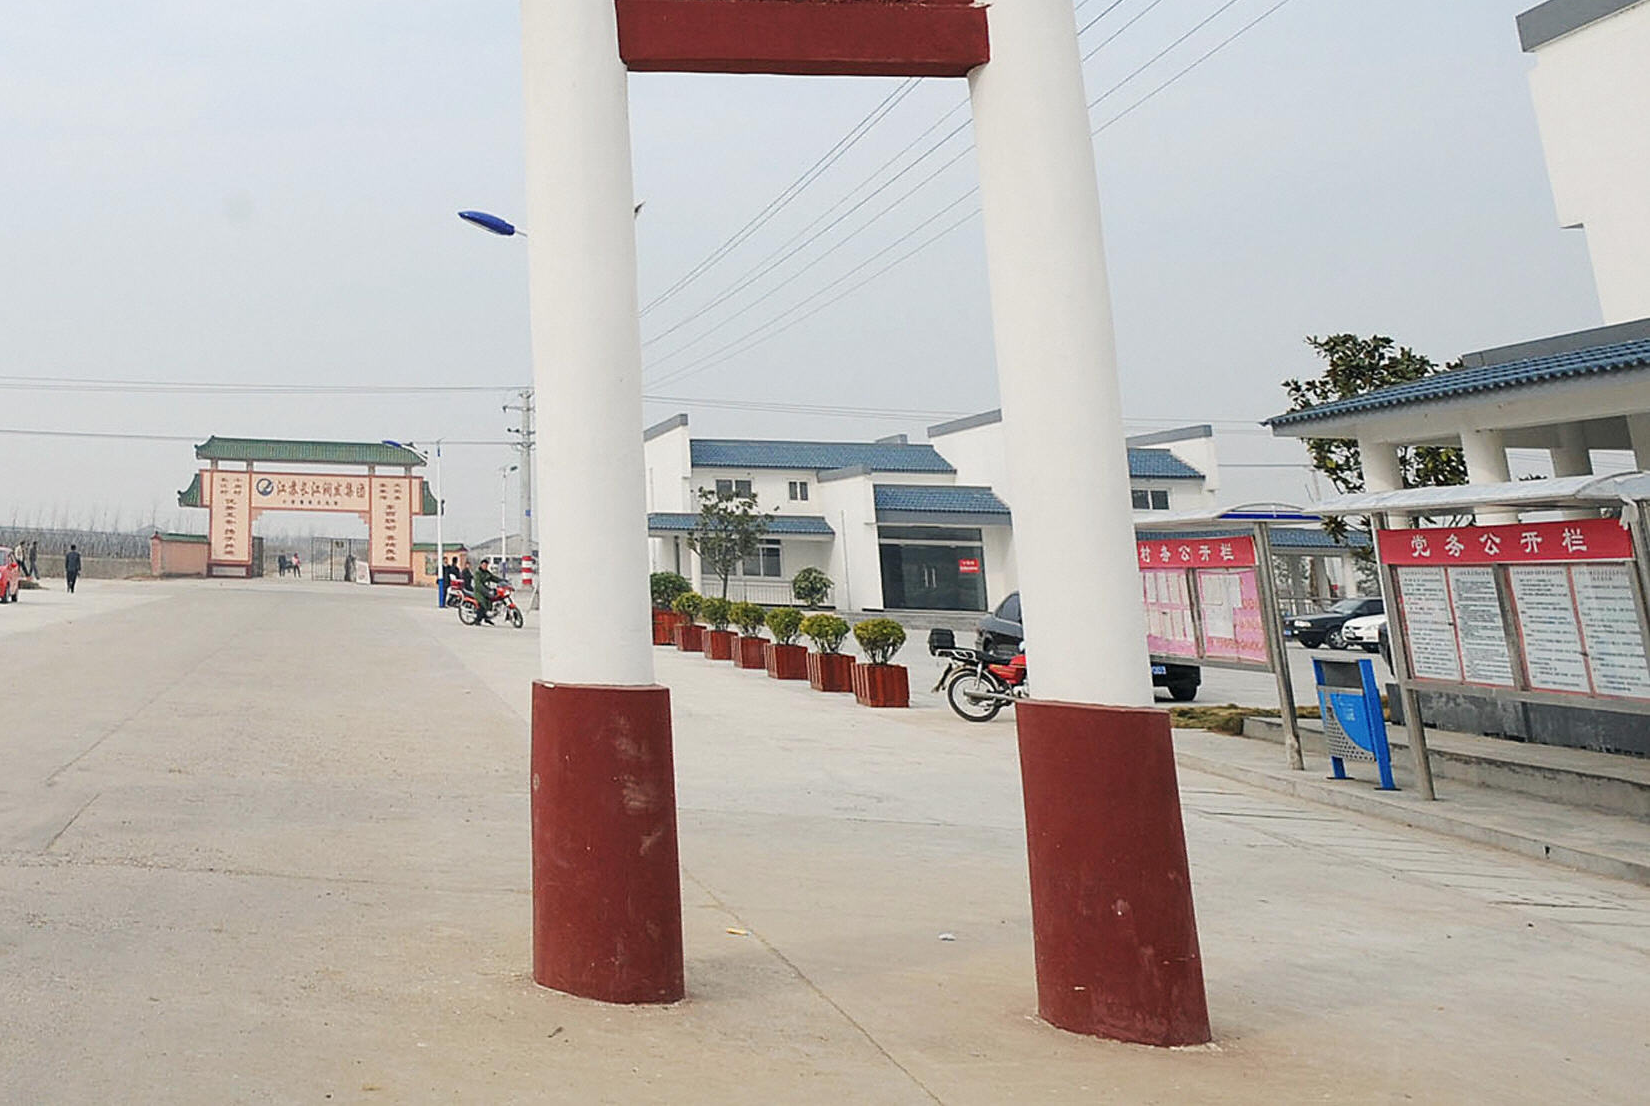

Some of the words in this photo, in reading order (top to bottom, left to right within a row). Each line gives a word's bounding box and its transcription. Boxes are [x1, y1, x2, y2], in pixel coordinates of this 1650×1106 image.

[1139, 543, 1235, 563] 村务公开栏
[1410, 528, 1588, 558] 党务公开栏
